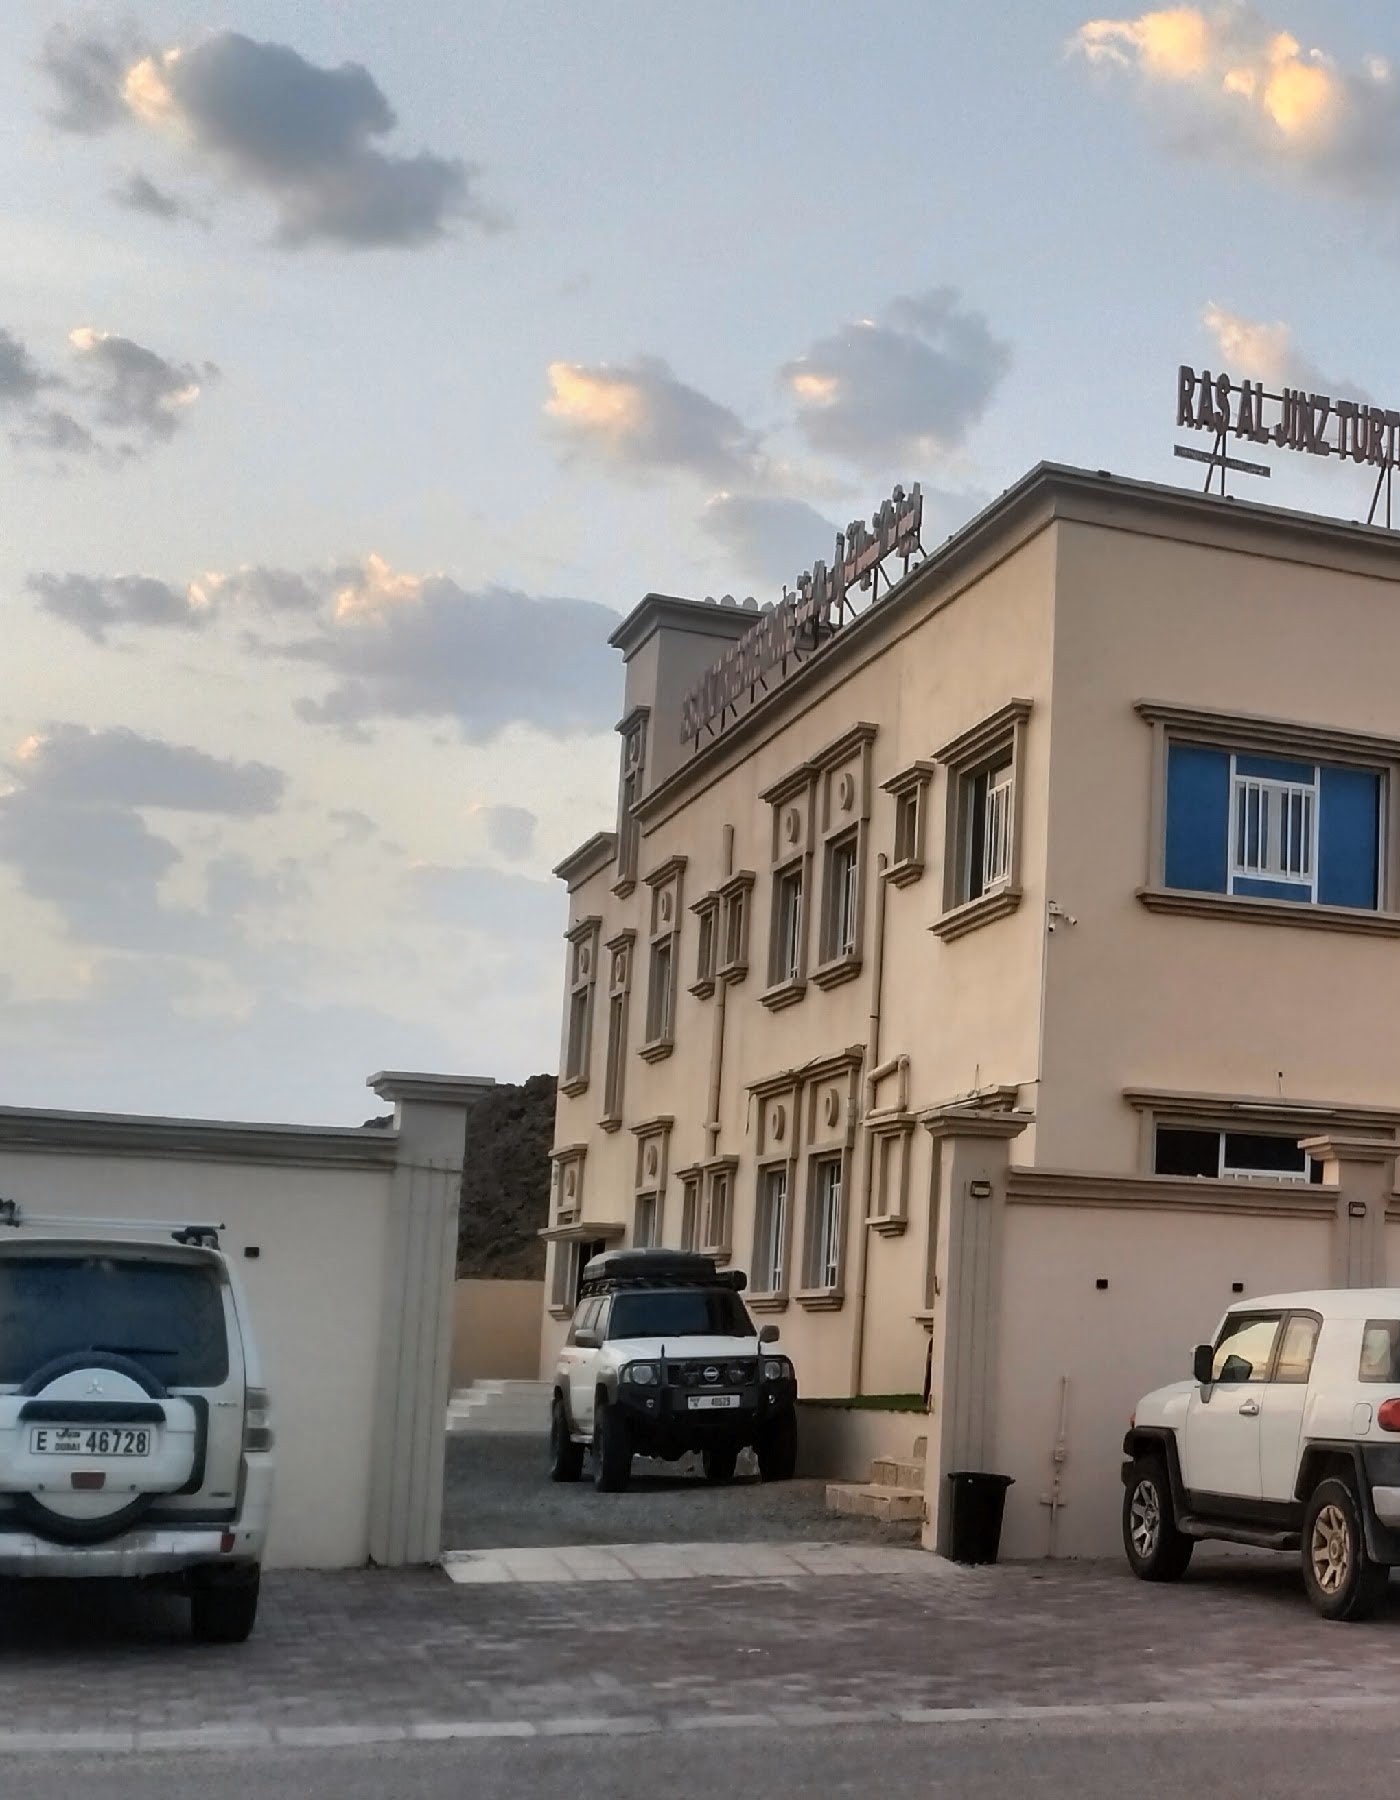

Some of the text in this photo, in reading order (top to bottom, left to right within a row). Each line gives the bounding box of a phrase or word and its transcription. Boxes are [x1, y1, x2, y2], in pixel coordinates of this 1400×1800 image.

[1176, 364, 1231, 434] RAS
[1235, 379, 1269, 445] AL
[1275, 387, 1331, 456] JINZ
[37, 1430, 146, 1453] E 46728
